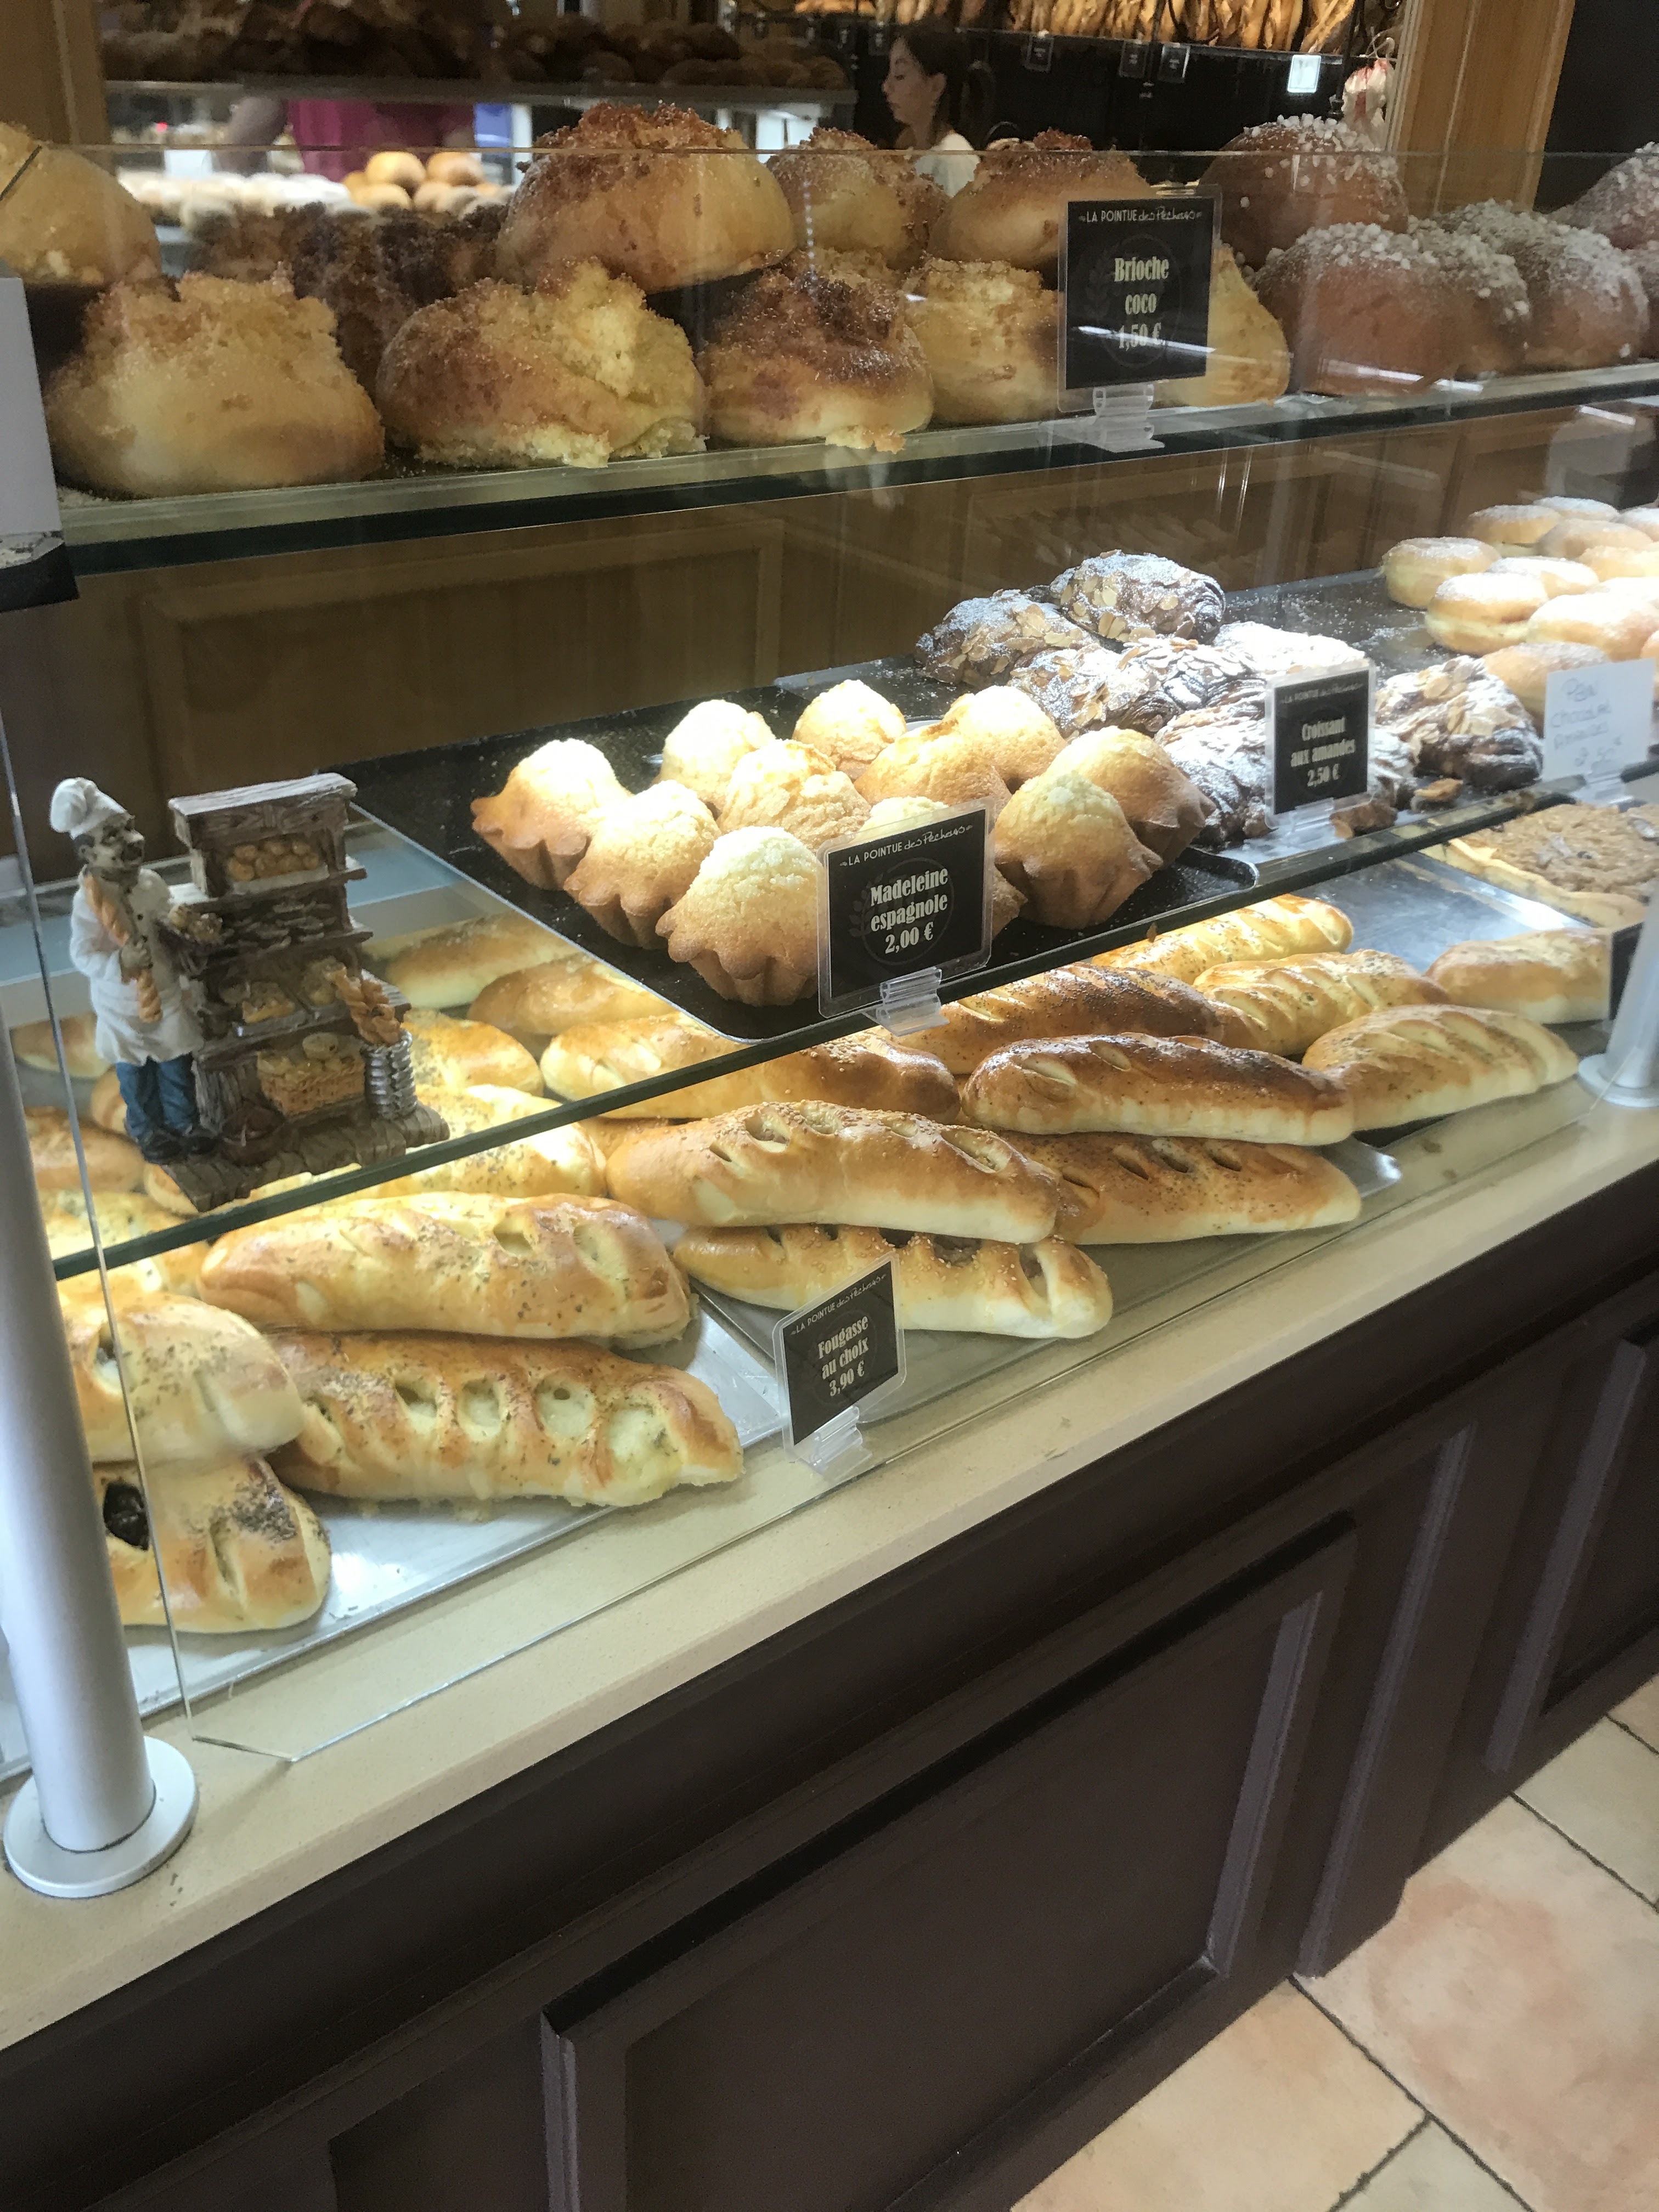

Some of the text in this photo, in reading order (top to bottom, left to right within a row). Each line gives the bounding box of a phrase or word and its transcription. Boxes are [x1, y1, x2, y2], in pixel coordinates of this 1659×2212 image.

[1087, 210, 1097, 222] LA
[1101, 209, 1137, 222] POINTUE
[1114, 256, 1169, 282] Brioche
[1125, 292, 1156, 315] coco
[848, 855, 860, 866] LA
[864, 842, 902, 861] POINTUE
[904, 834, 922, 850] des
[871, 868, 948, 906] Madeleine
[871, 894, 947, 932] espagnole
[885, 922, 933, 953] 2,00 €
[797, 1322, 804, 1333] LA
[808, 1302, 836, 1327] POINTUE
[818, 1316, 868, 1359] Fougasse
[822, 1337, 869, 1379] au choix
[829, 1360, 865, 1397] 3,90 €
